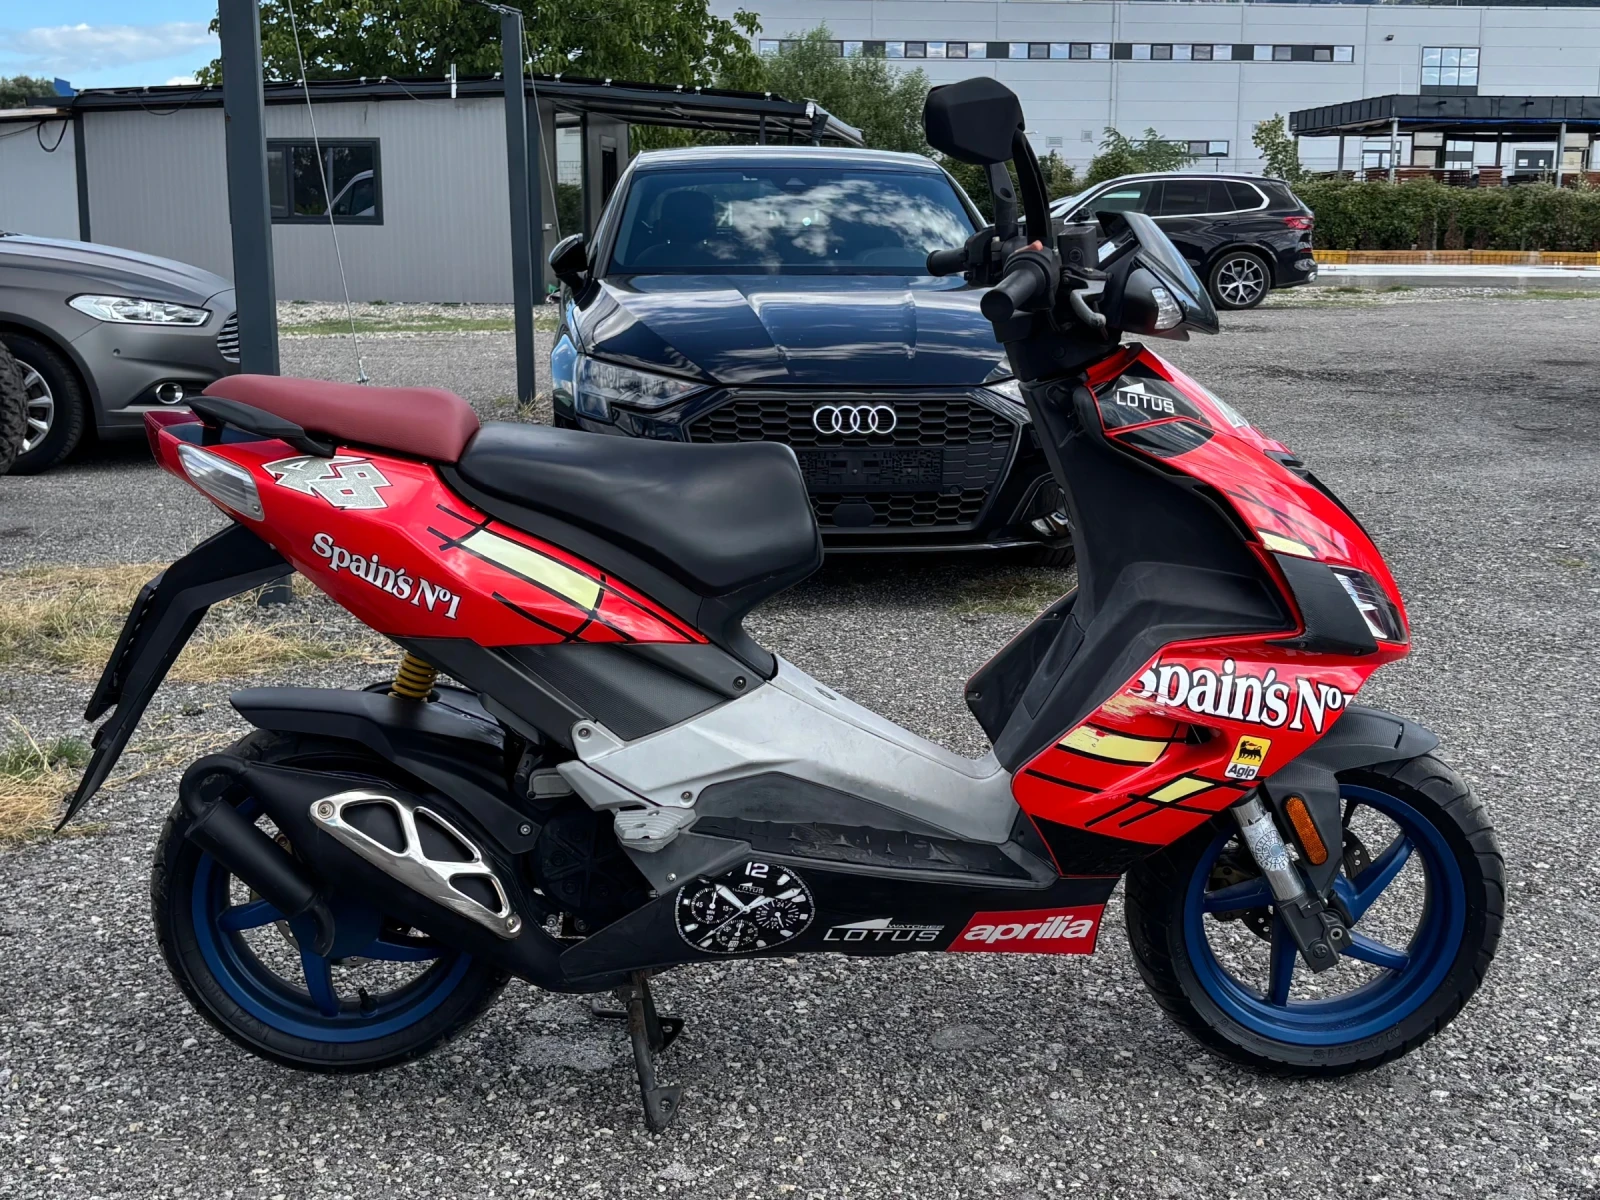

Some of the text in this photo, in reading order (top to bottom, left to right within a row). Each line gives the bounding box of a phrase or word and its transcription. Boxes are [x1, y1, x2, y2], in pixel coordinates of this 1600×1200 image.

[1116, 391, 1175, 414] LOTUS
[312, 532, 414, 600] Spain's
[1227, 762, 1257, 779] Agip
[744, 861, 770, 879] 12
[823, 929, 940, 941] LOTUS
[963, 915, 1094, 944] aprilia
